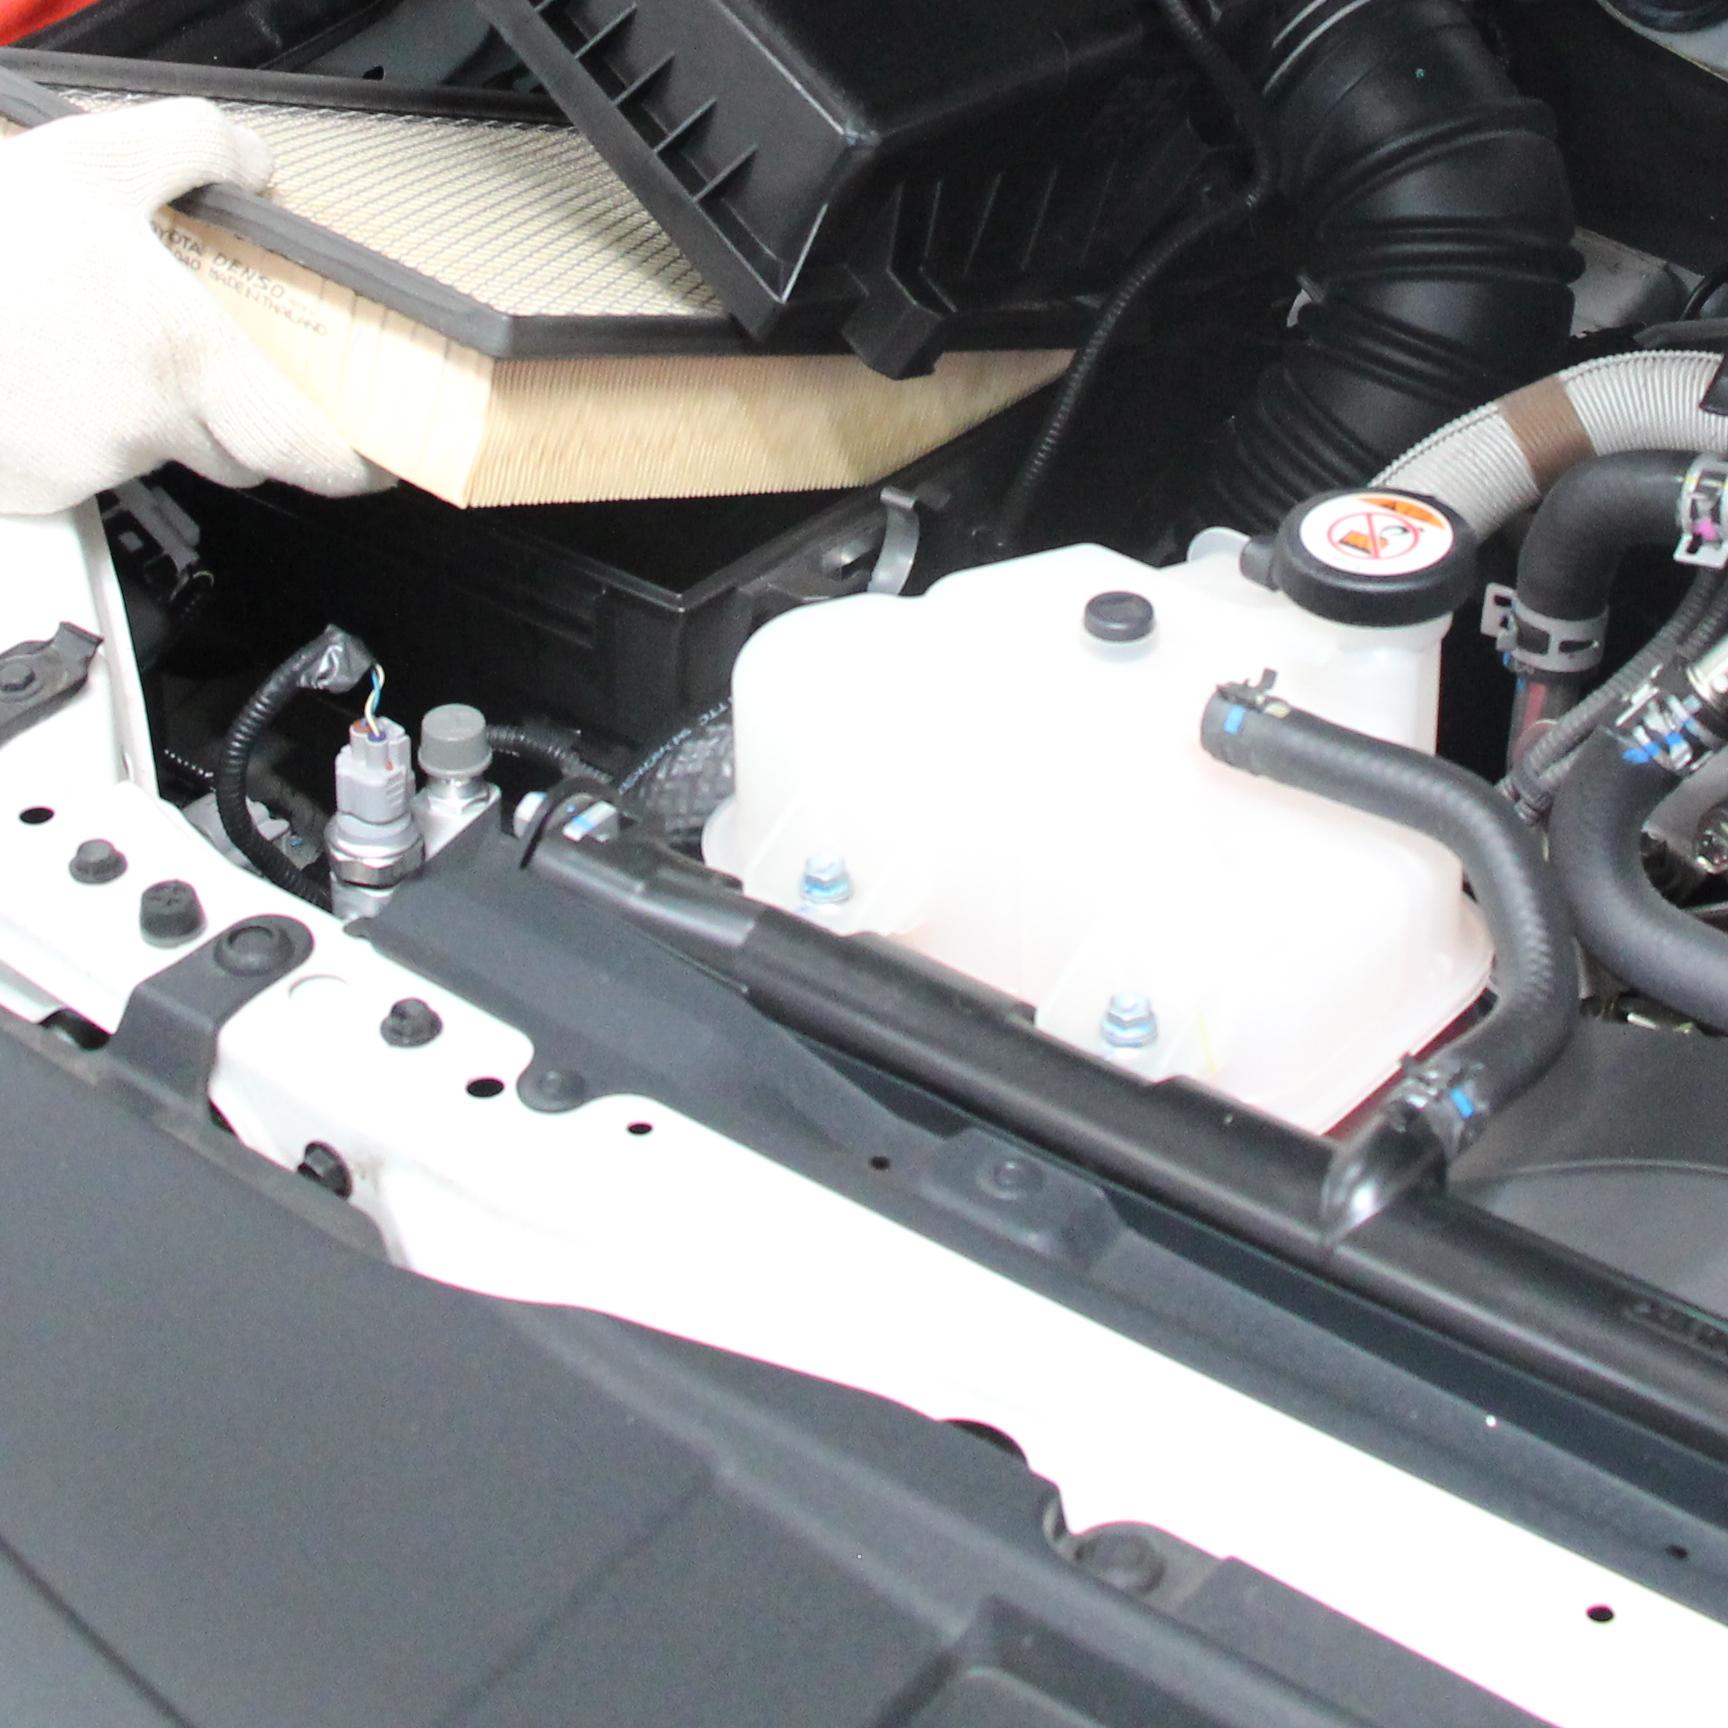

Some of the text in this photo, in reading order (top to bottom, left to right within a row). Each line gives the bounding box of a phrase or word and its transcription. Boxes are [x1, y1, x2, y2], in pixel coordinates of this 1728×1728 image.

[152, 226, 285, 299] YOTA DENSO
[172, 249, 202, 272] 040
